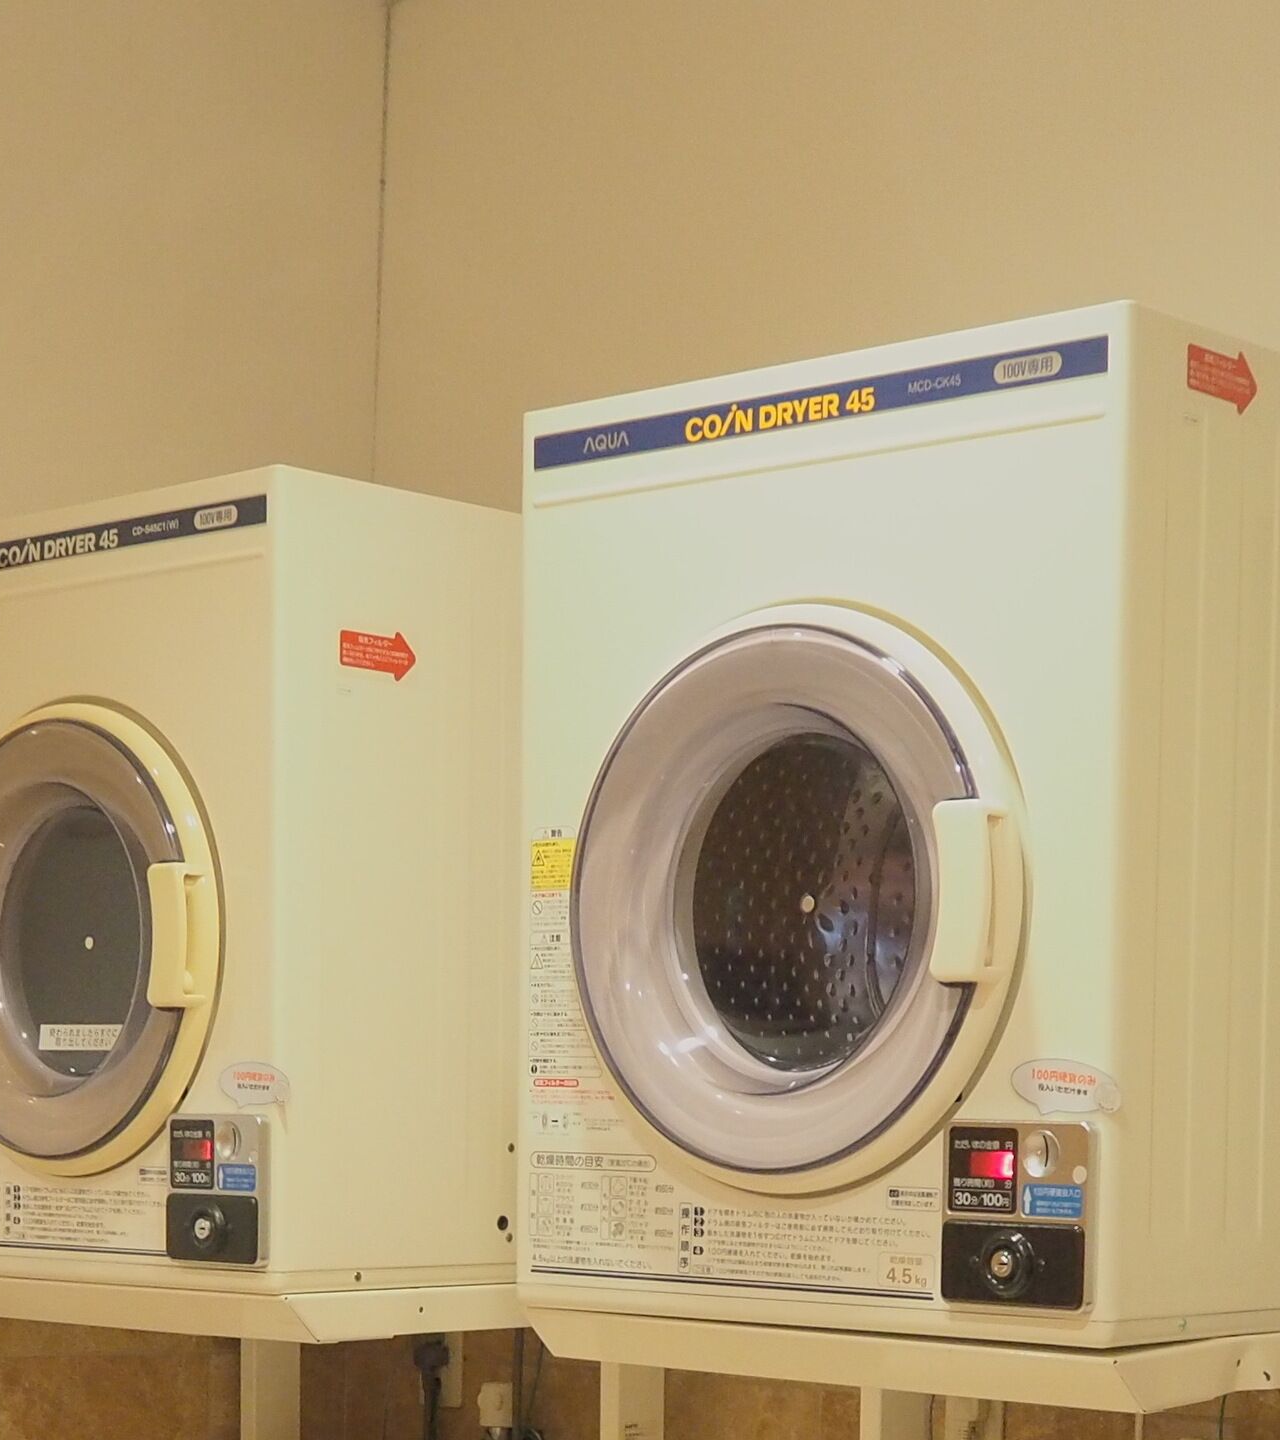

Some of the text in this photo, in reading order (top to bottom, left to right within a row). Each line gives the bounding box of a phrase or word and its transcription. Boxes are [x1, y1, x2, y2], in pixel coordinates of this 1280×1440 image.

[1001, 357, 1055, 379] 100V専用
[584, 430, 629, 454] AQUA
[758, 396, 840, 433] DRYER
[845, 387, 876, 416] 45
[908, 373, 962, 396] MCD-CK45
[43, 533, 97, 560] DRYER
[99, 528, 119, 549] 45
[536, 1155, 604, 1168] 乾燥時間の目安
